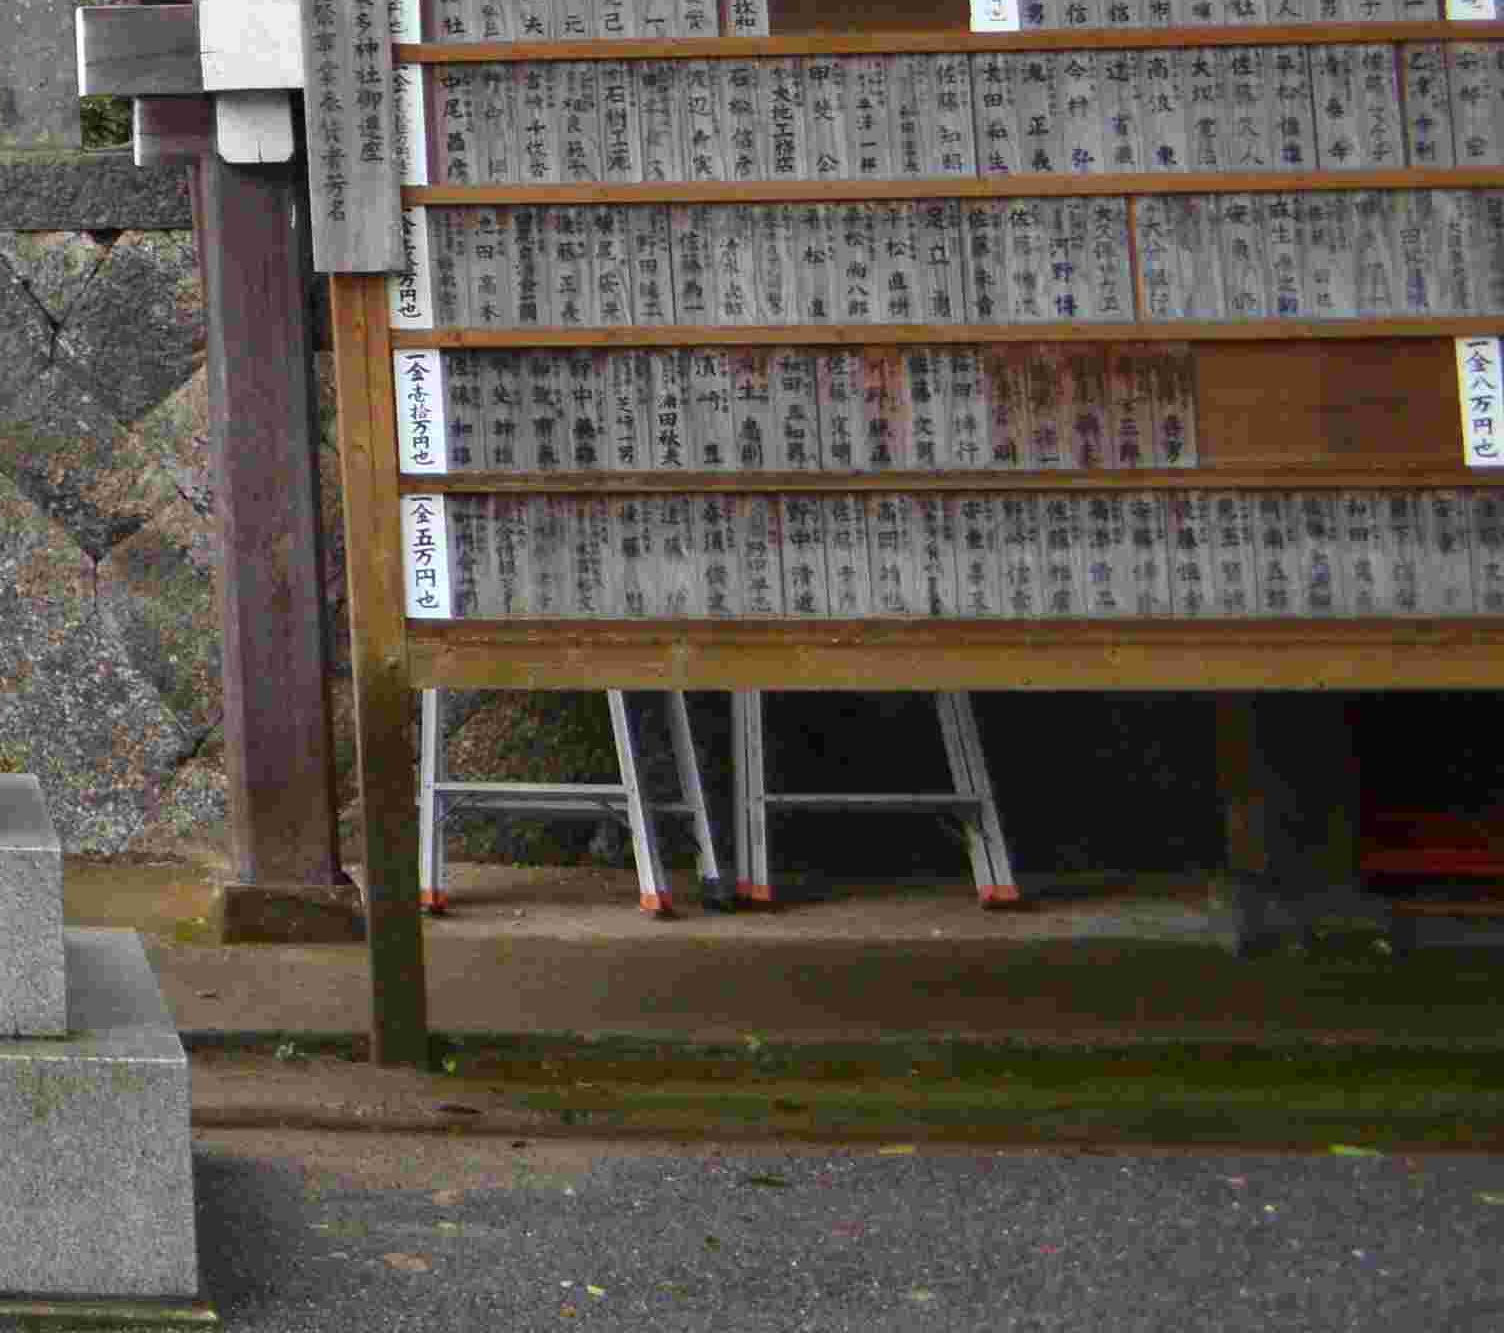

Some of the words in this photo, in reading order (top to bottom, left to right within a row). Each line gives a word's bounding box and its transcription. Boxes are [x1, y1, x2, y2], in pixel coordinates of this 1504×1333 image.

[404, 354, 435, 467] 一金壱拾万円也
[1466, 339, 1497, 460] 一金八万円也
[409, 497, 439, 610] 一金五万円也
